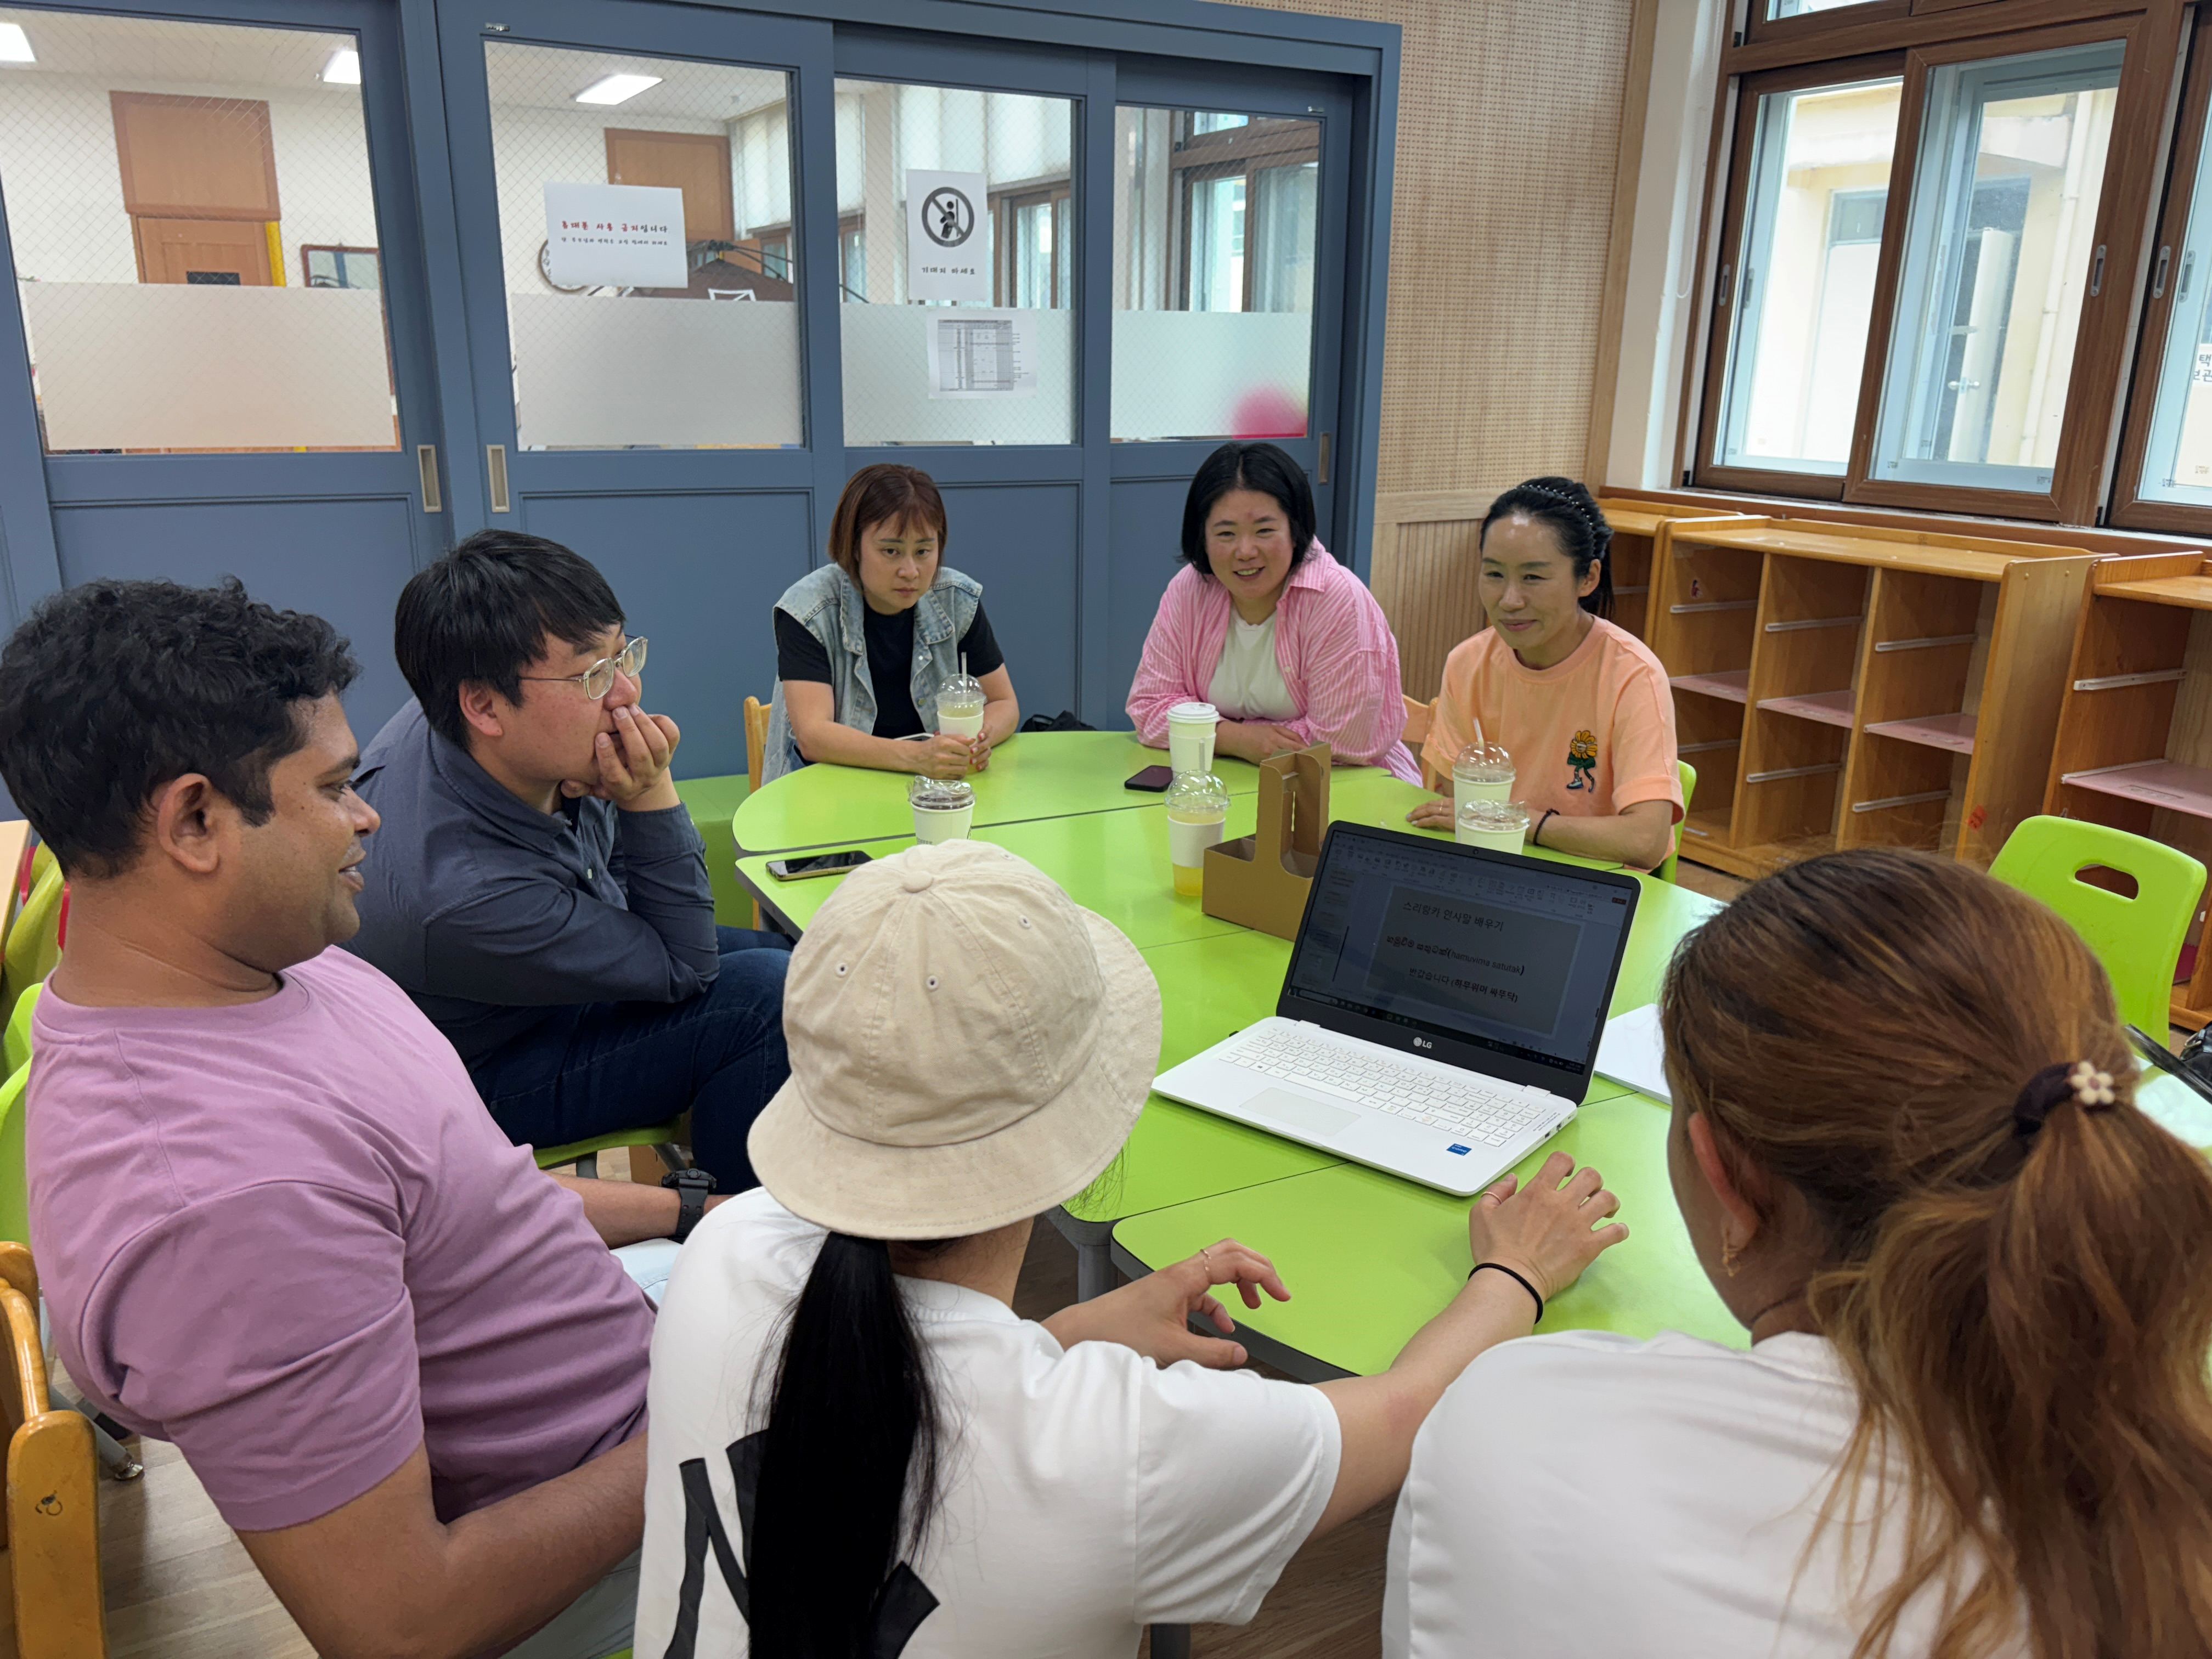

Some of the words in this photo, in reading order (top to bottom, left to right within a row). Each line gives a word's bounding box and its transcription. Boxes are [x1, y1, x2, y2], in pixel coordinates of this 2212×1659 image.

[596, 223, 613, 232] 사용
[621, 223, 668, 233] 금지입니다
[1403, 901, 1441, 919] 스리랑카
[1443, 909, 1472, 925] 인사말
[1474, 916, 1504, 932] 배우기
[1409, 967, 1449, 985] 반갑습니다
[1422, 1040, 1432, 1049] LG
